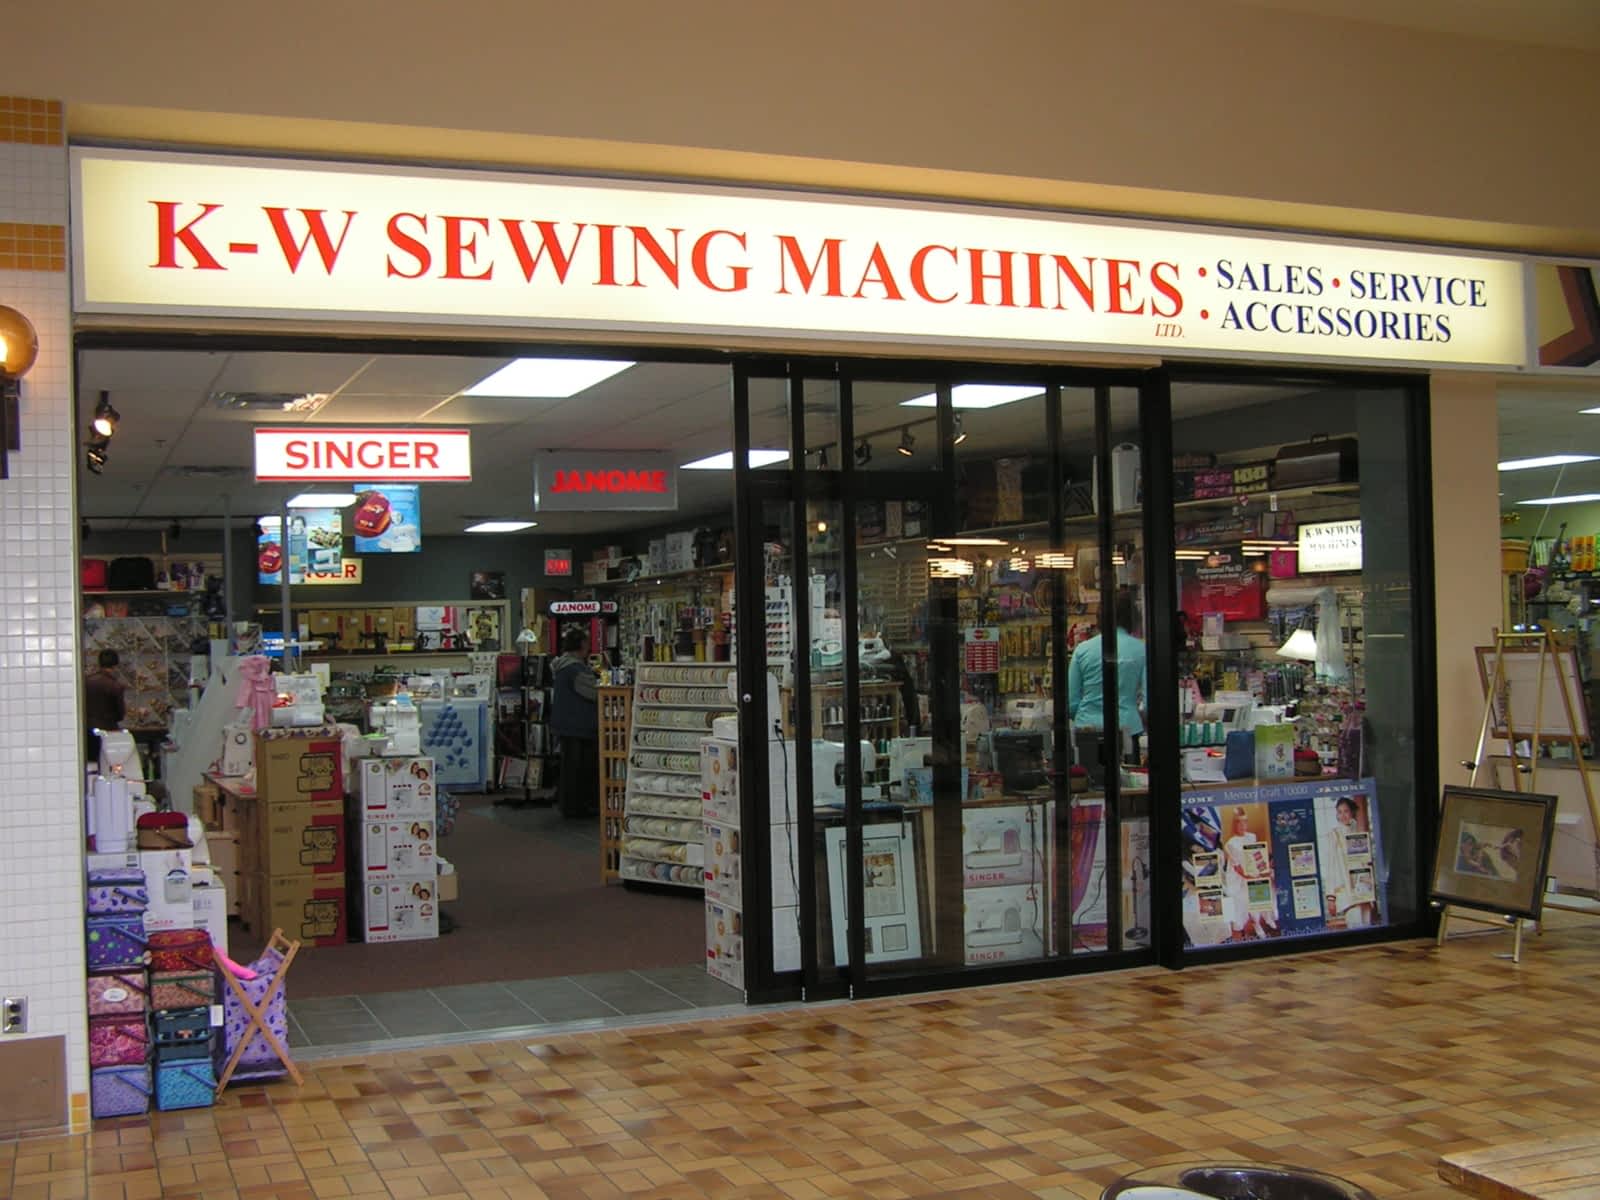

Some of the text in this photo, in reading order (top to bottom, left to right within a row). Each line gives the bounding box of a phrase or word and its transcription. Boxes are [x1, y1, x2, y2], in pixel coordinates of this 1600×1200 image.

[154, 200, 1184, 318] K-W SEWING MACHINES
[1217, 260, 1487, 307] SALES SERVICE
[1222, 302, 1452, 343] ACCESSORIES
[285, 440, 439, 469] SINGER
[551, 469, 669, 493] JANOME
[555, 603, 597, 612] JANOME
[1316, 783, 1367, 794] JANOME
[969, 872, 1005, 882] SINGER
[970, 951, 1005, 960] SINGER
